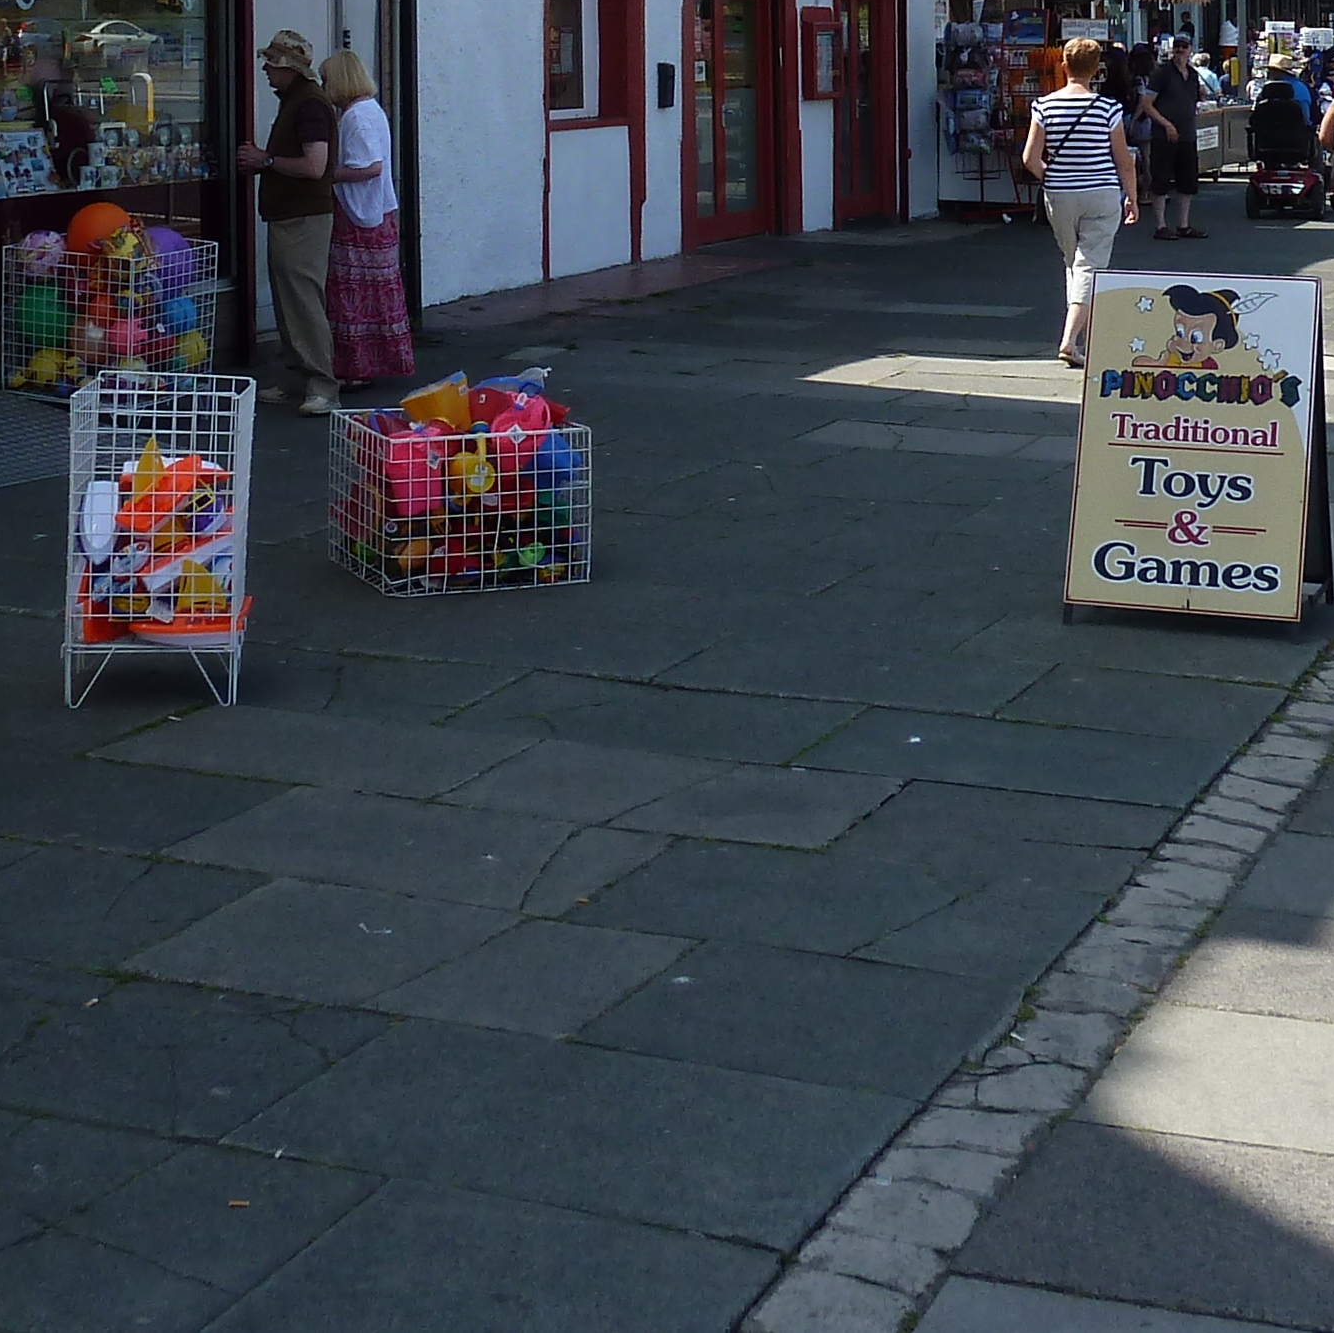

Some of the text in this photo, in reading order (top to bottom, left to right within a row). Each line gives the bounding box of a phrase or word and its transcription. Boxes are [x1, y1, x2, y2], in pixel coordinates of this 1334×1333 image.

[1099, 368, 1304, 409] PINOCCHIO'S
[1111, 412, 1279, 448] Traditional
[1130, 456, 1253, 508] Toys
[1167, 509, 1210, 546] &
[1092, 541, 1280, 593] Games
